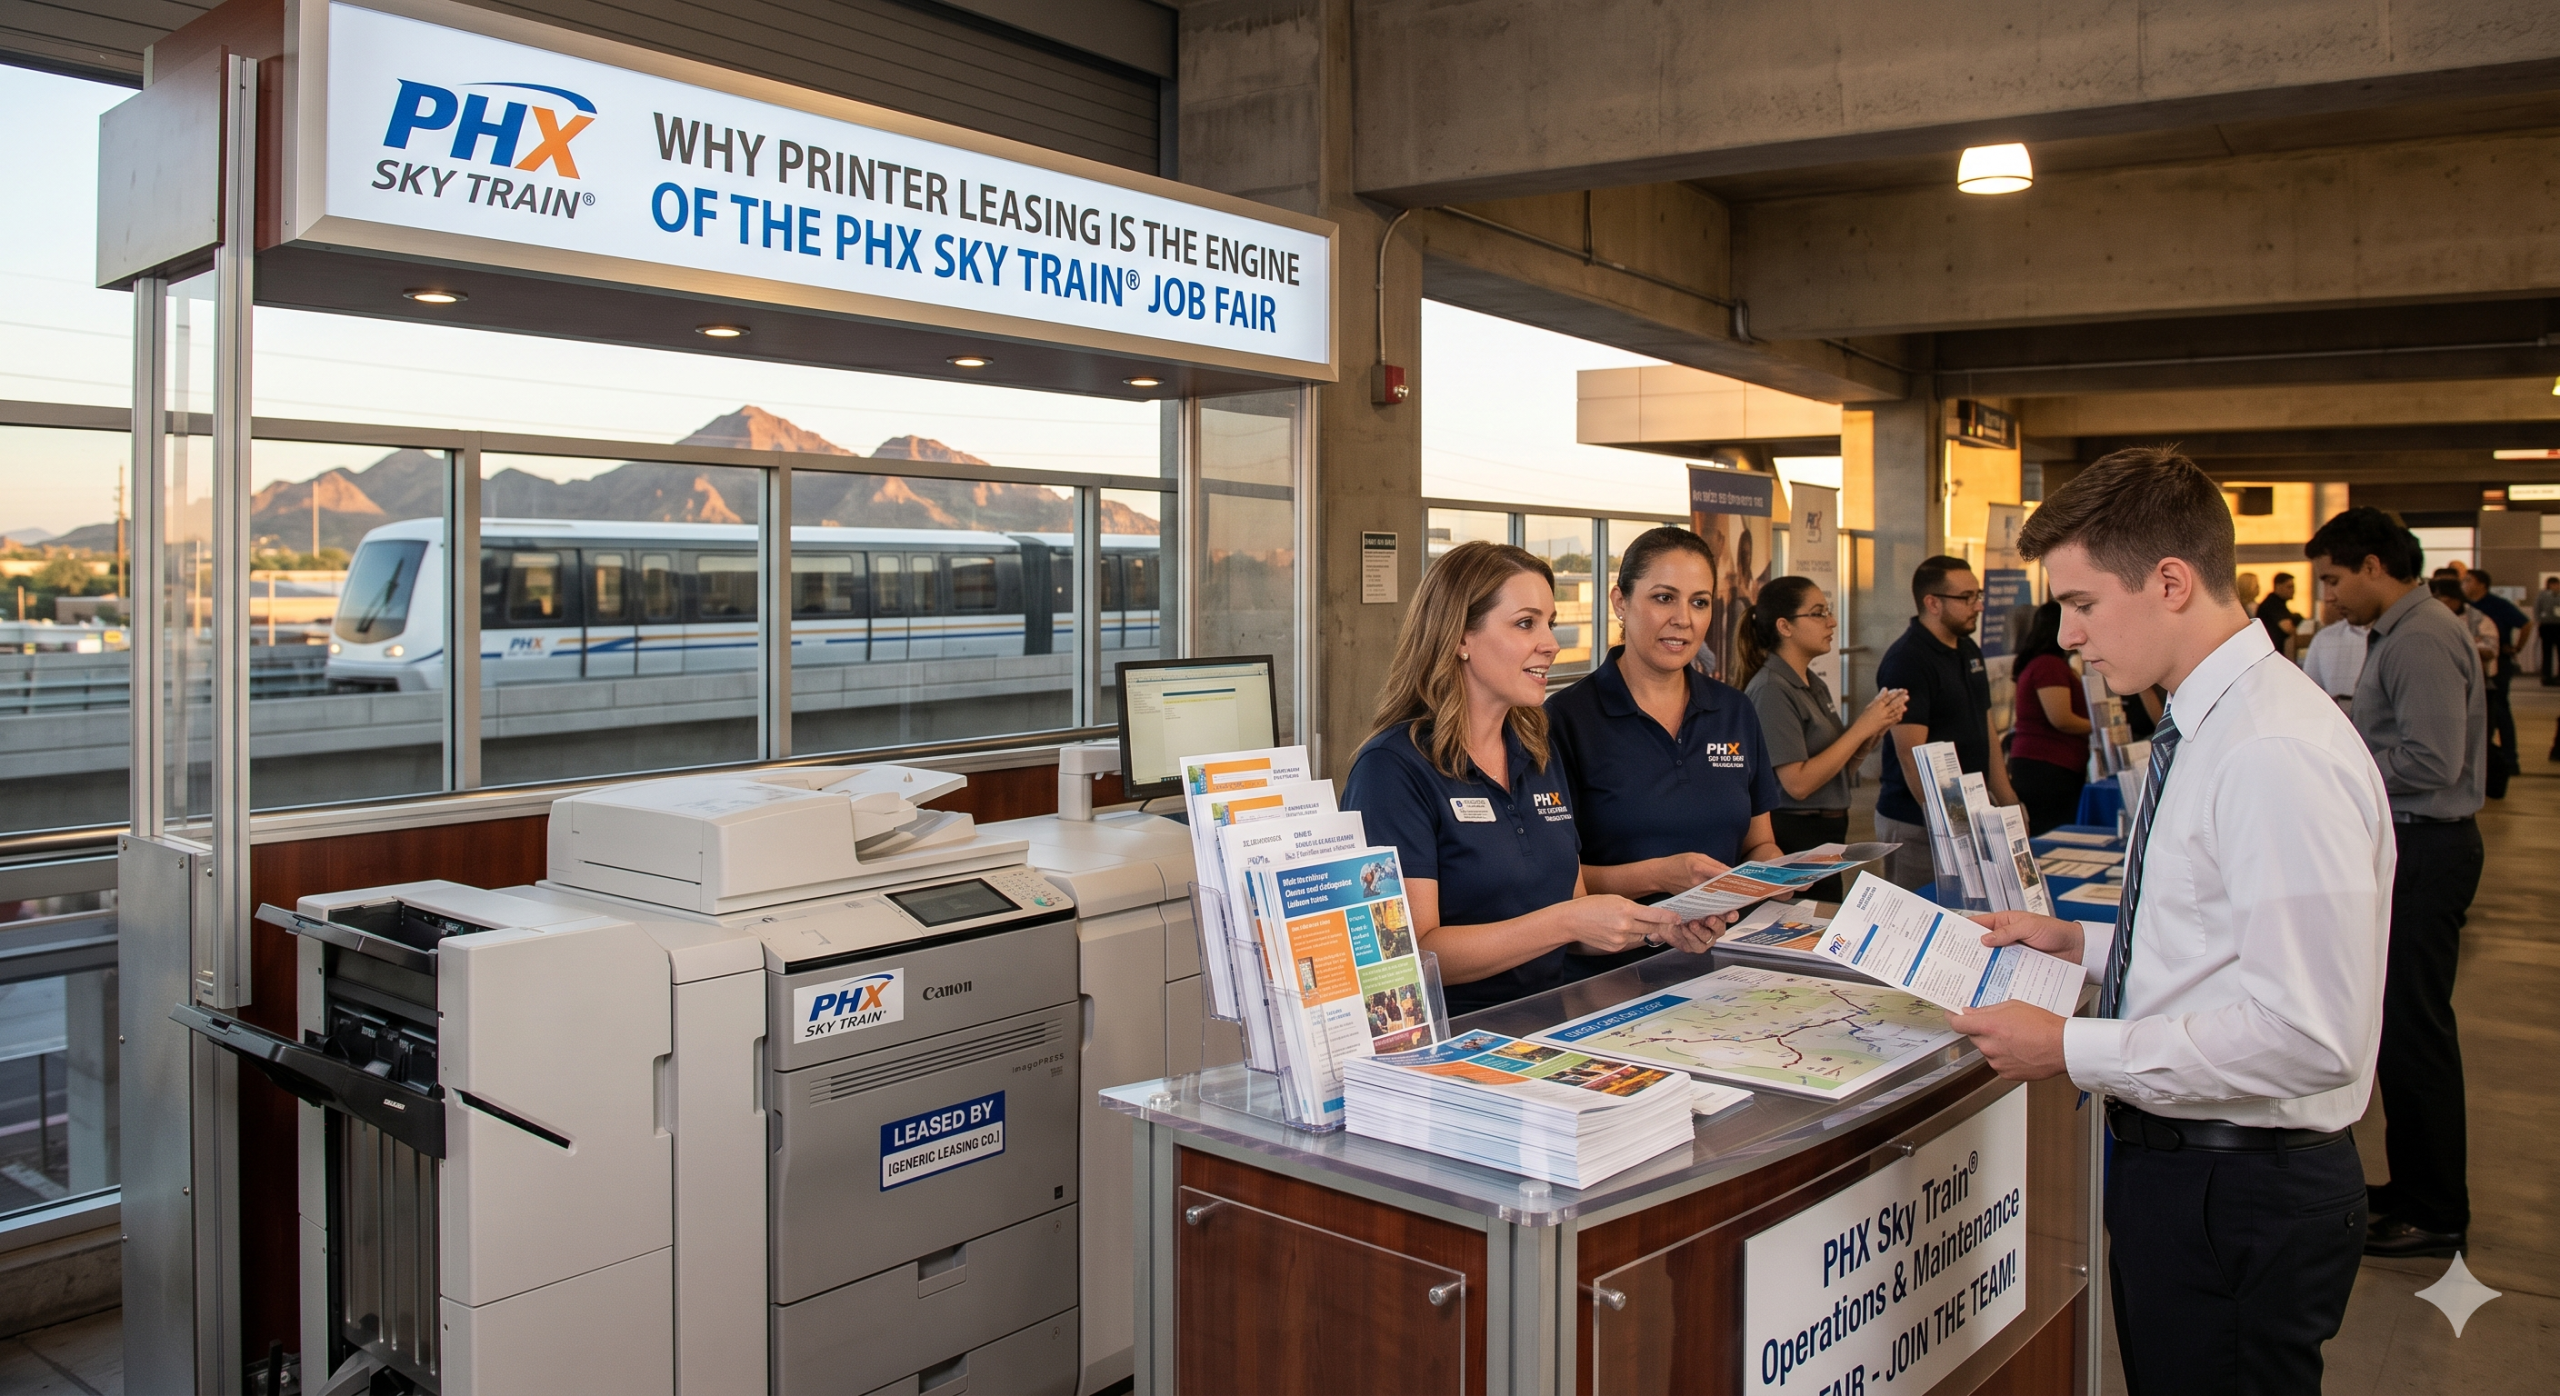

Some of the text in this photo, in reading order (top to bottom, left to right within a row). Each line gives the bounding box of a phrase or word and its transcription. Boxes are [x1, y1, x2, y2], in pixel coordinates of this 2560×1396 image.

[383, 78, 595, 179] PHX
[372, 159, 596, 219] SKY TRAIN®
[653, 112, 1300, 287] WHY PRINTER LEASING IS THE ENGINE
[651, 181, 1277, 333] OF THE PHX SKY TRAIN® JOB FAIR
[510, 636, 545, 650] PHX
[1706, 742, 1740, 756] PHX
[1533, 791, 1562, 807] PHX
[808, 980, 892, 1022] PHX
[922, 980, 973, 1001] Canon
[804, 1020, 837, 1038] SKY
[893, 1100, 995, 1147] LEASED BY
[888, 1150, 936, 1177] [GENERIC
[937, 1138, 979, 1162] LEASING
[1823, 1150, 1979, 1289] PHX Sky Train®
[1762, 1187, 2020, 1386] Operations & Maintenance
[1819, 1364, 1865, 1396] IR
[1886, 1317, 1929, 1383] JOIN
[1933, 1288, 1966, 1345] THE
[1970, 1249, 2017, 1317] TEAM!
